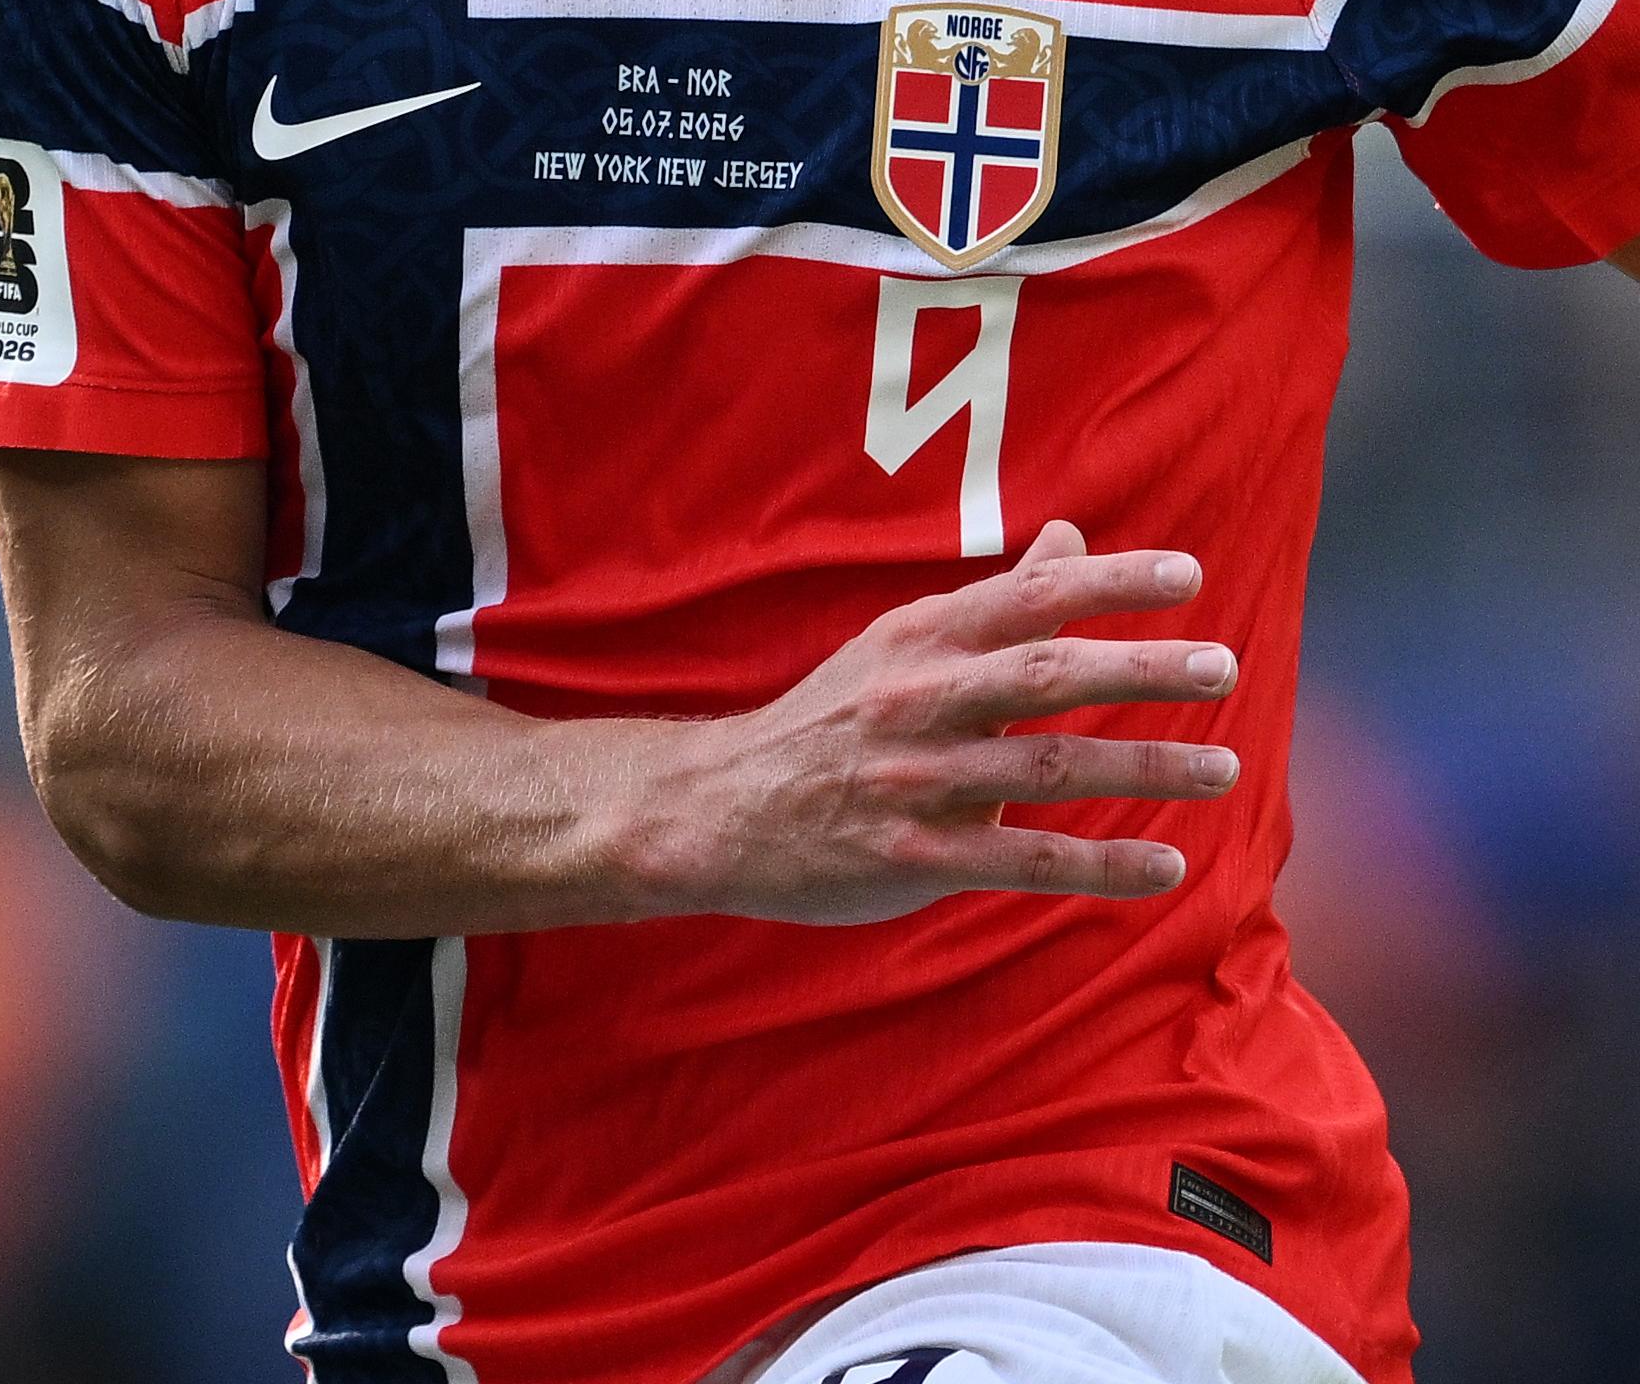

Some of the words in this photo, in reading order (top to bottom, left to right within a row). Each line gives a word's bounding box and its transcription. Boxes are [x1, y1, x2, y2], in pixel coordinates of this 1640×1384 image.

[946, 14, 1003, 40] NORGE
[617, 64, 660, 94] BRA
[686, 68, 733, 98] NOR
[601, 107, 745, 142] 05.07.2026
[533, 151, 586, 180] NEW
[593, 153, 652, 184] YORK
[656, 157, 707, 187] NEW
[713, 160, 804, 189] JERSEY
[16, 322, 39, 337] CUP
[864, 275, 1027, 558] 9
